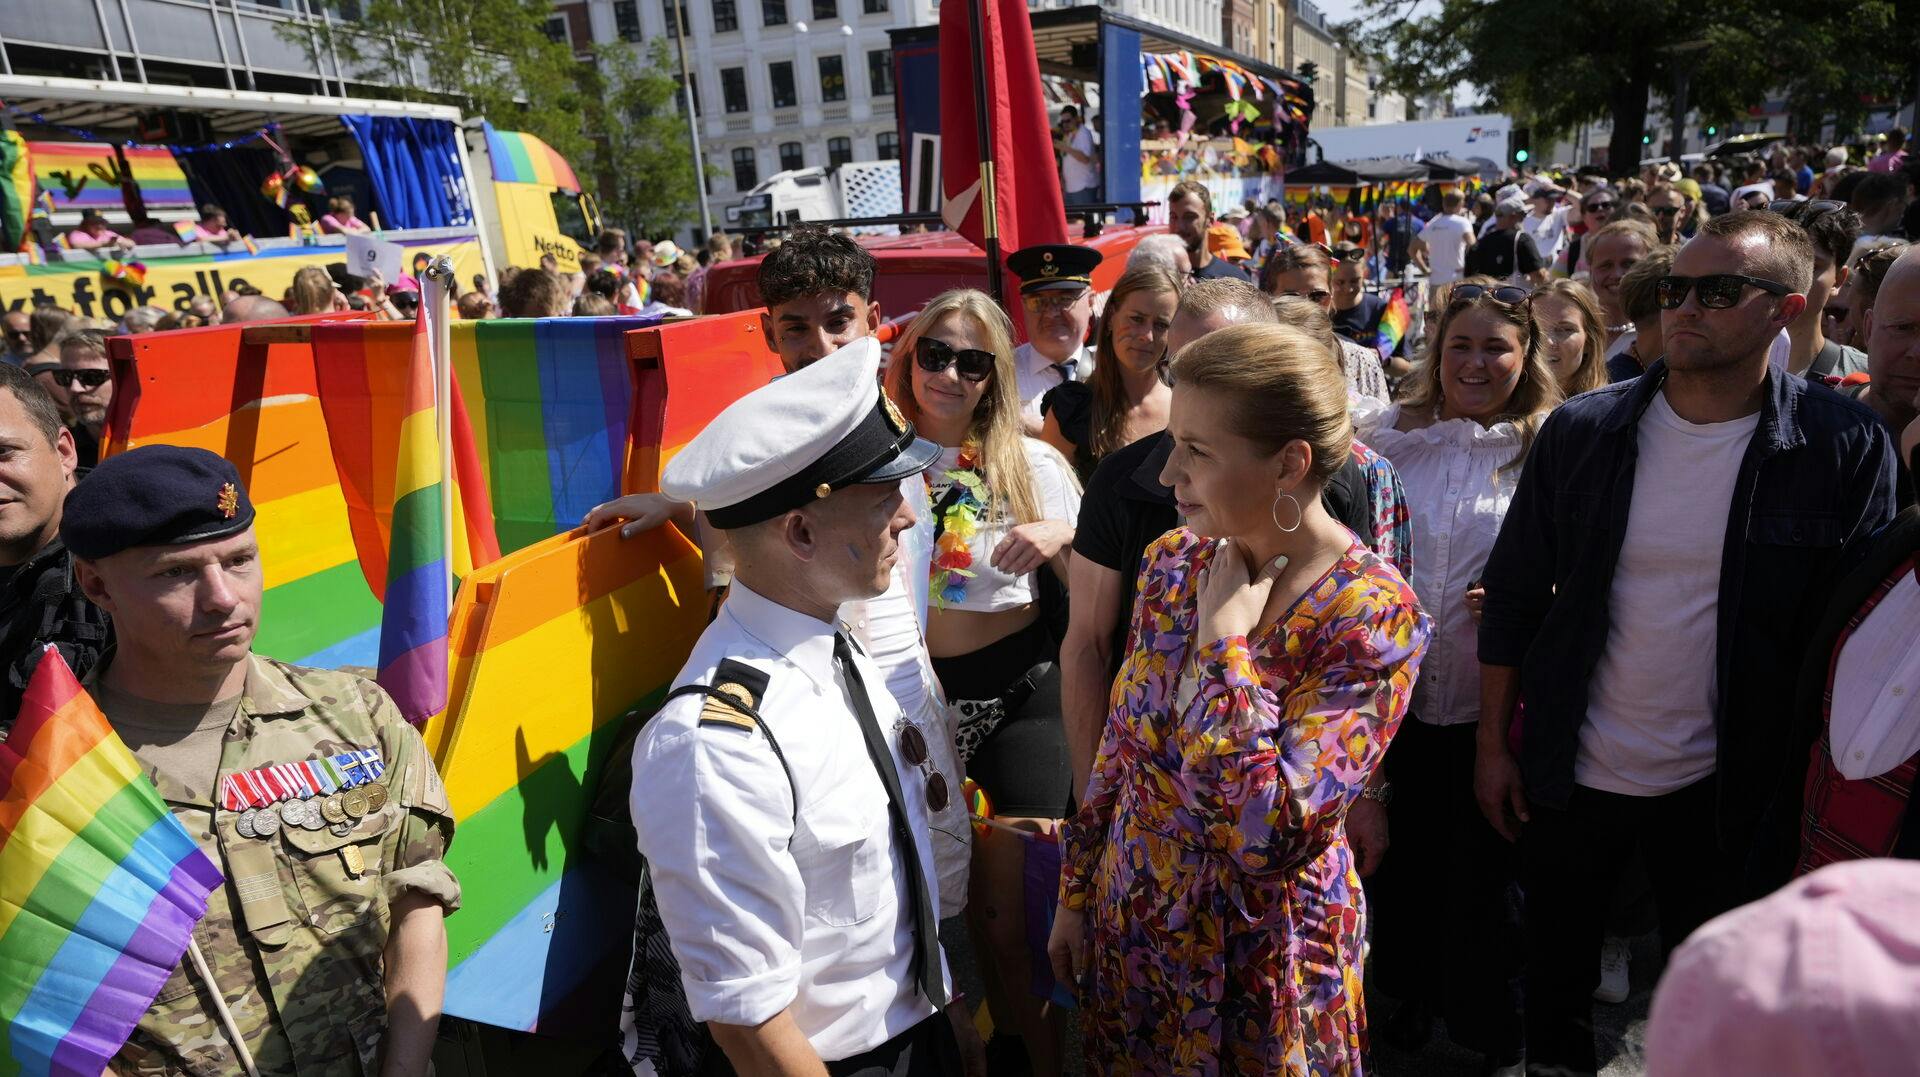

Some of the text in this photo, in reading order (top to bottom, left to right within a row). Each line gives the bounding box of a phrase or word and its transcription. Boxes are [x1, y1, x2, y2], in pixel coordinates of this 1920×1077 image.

[367, 249, 376, 262] 9
[534, 235, 575, 261] Netto
[72, 276, 156, 323] for
